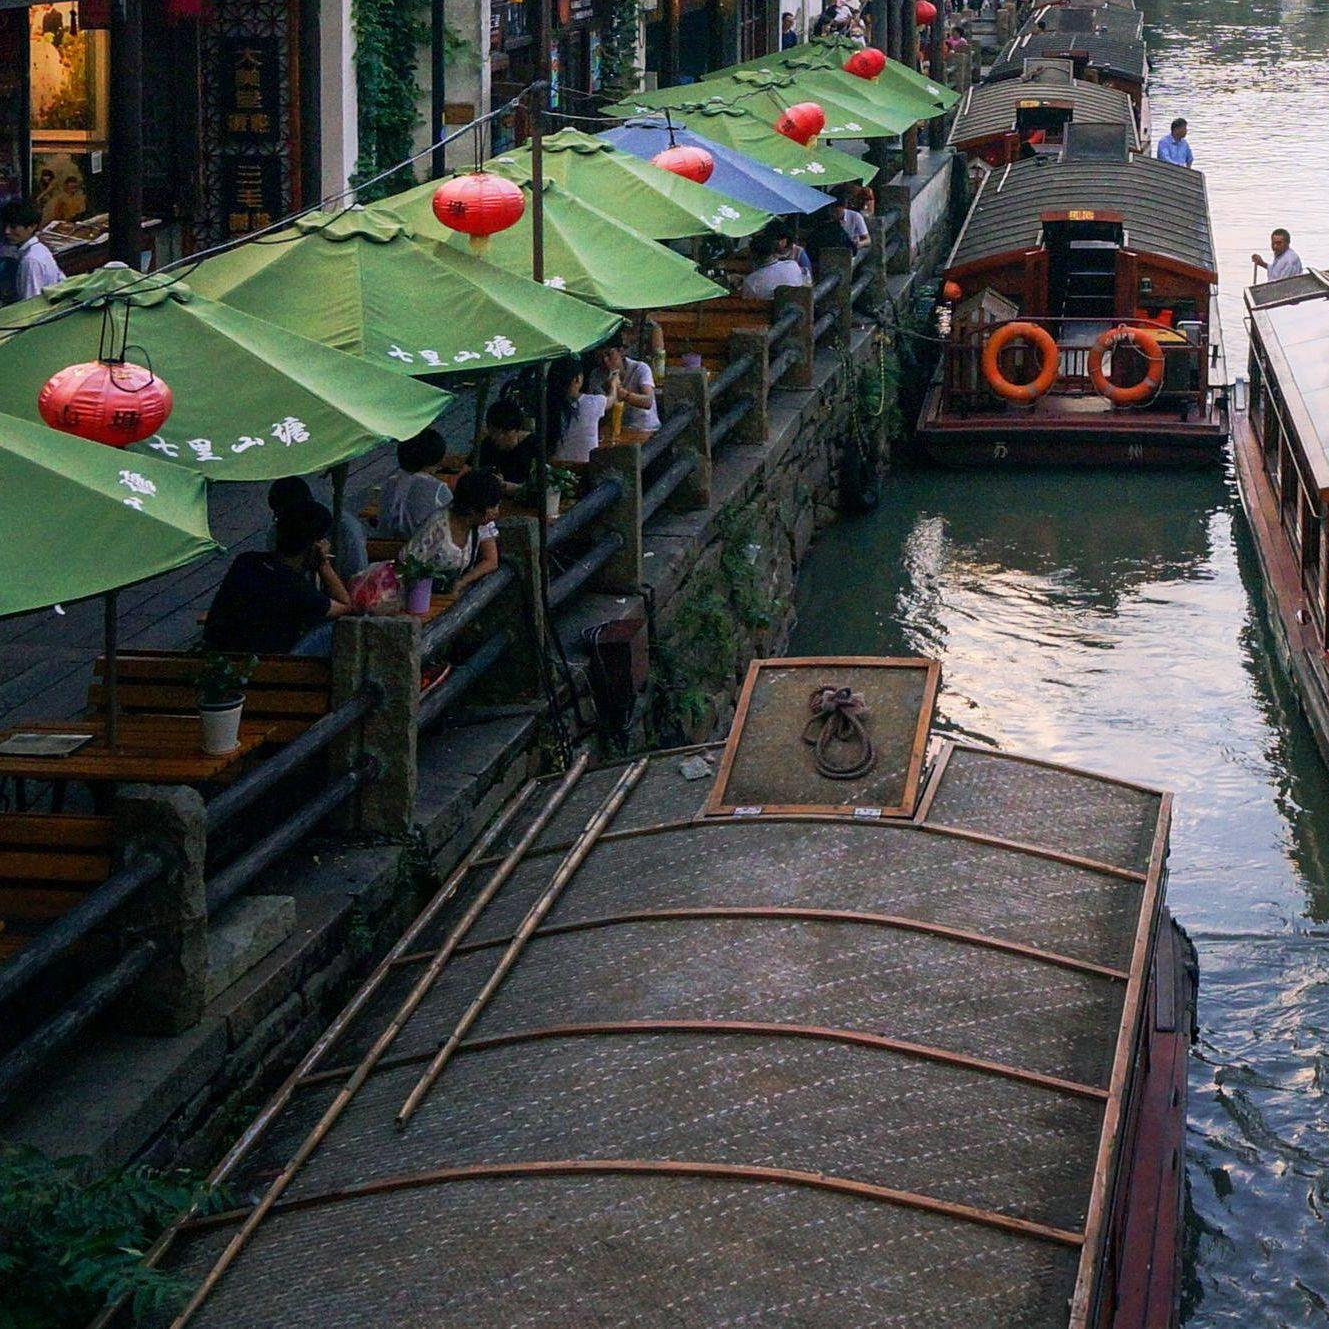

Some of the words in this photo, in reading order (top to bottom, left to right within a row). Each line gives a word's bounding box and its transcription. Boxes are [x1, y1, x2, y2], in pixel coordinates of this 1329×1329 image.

[387, 335, 517, 367] 七里山塘
[149, 416, 310, 462] 七里山塘
